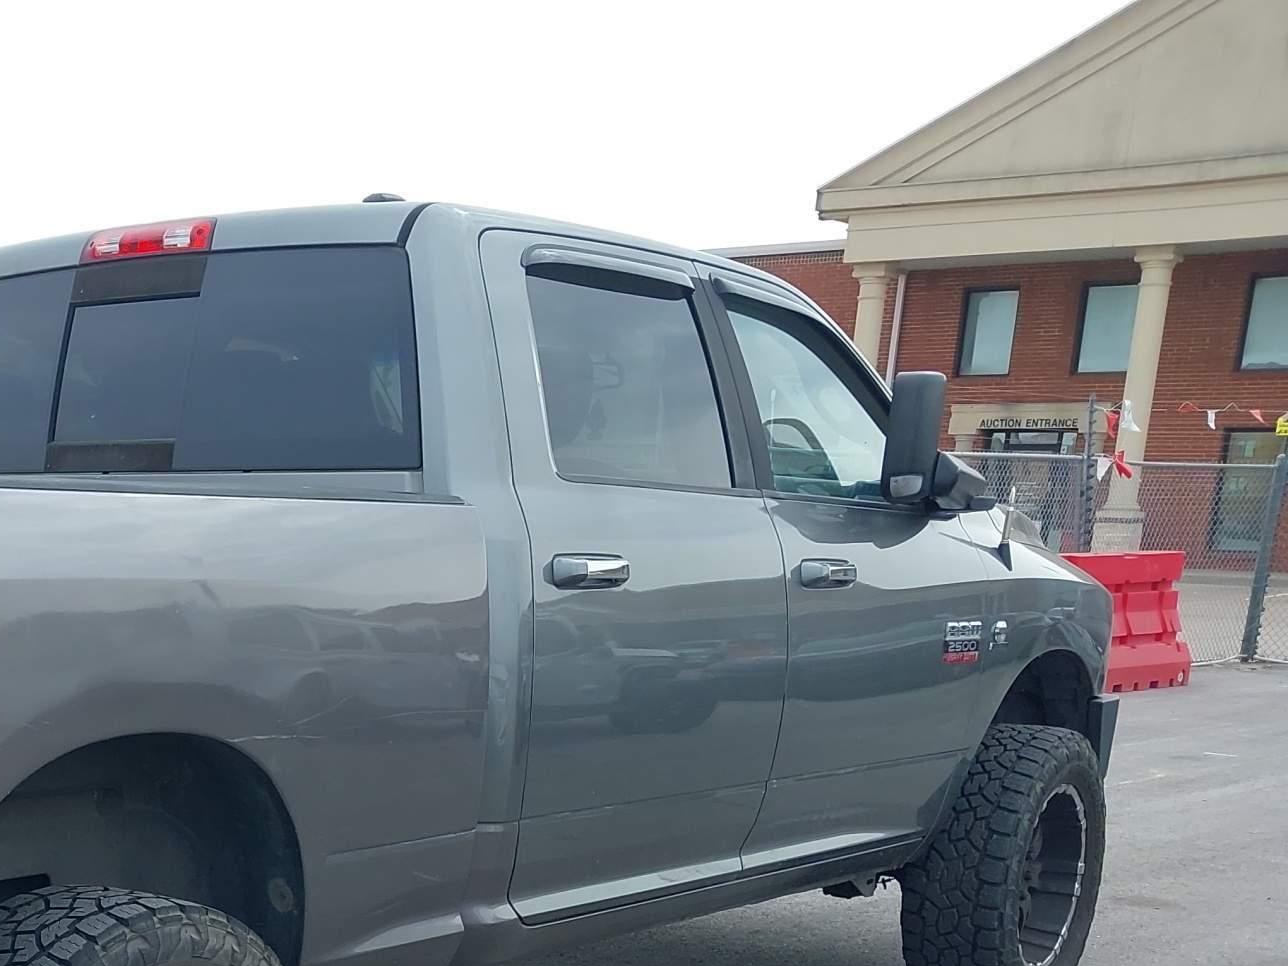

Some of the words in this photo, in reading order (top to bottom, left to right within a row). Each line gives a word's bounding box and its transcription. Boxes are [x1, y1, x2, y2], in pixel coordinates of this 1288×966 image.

[979, 418, 1021, 428] AUCTION
[1025, 418, 1078, 428] ENTRANCE
[947, 640, 977, 652] 2500
